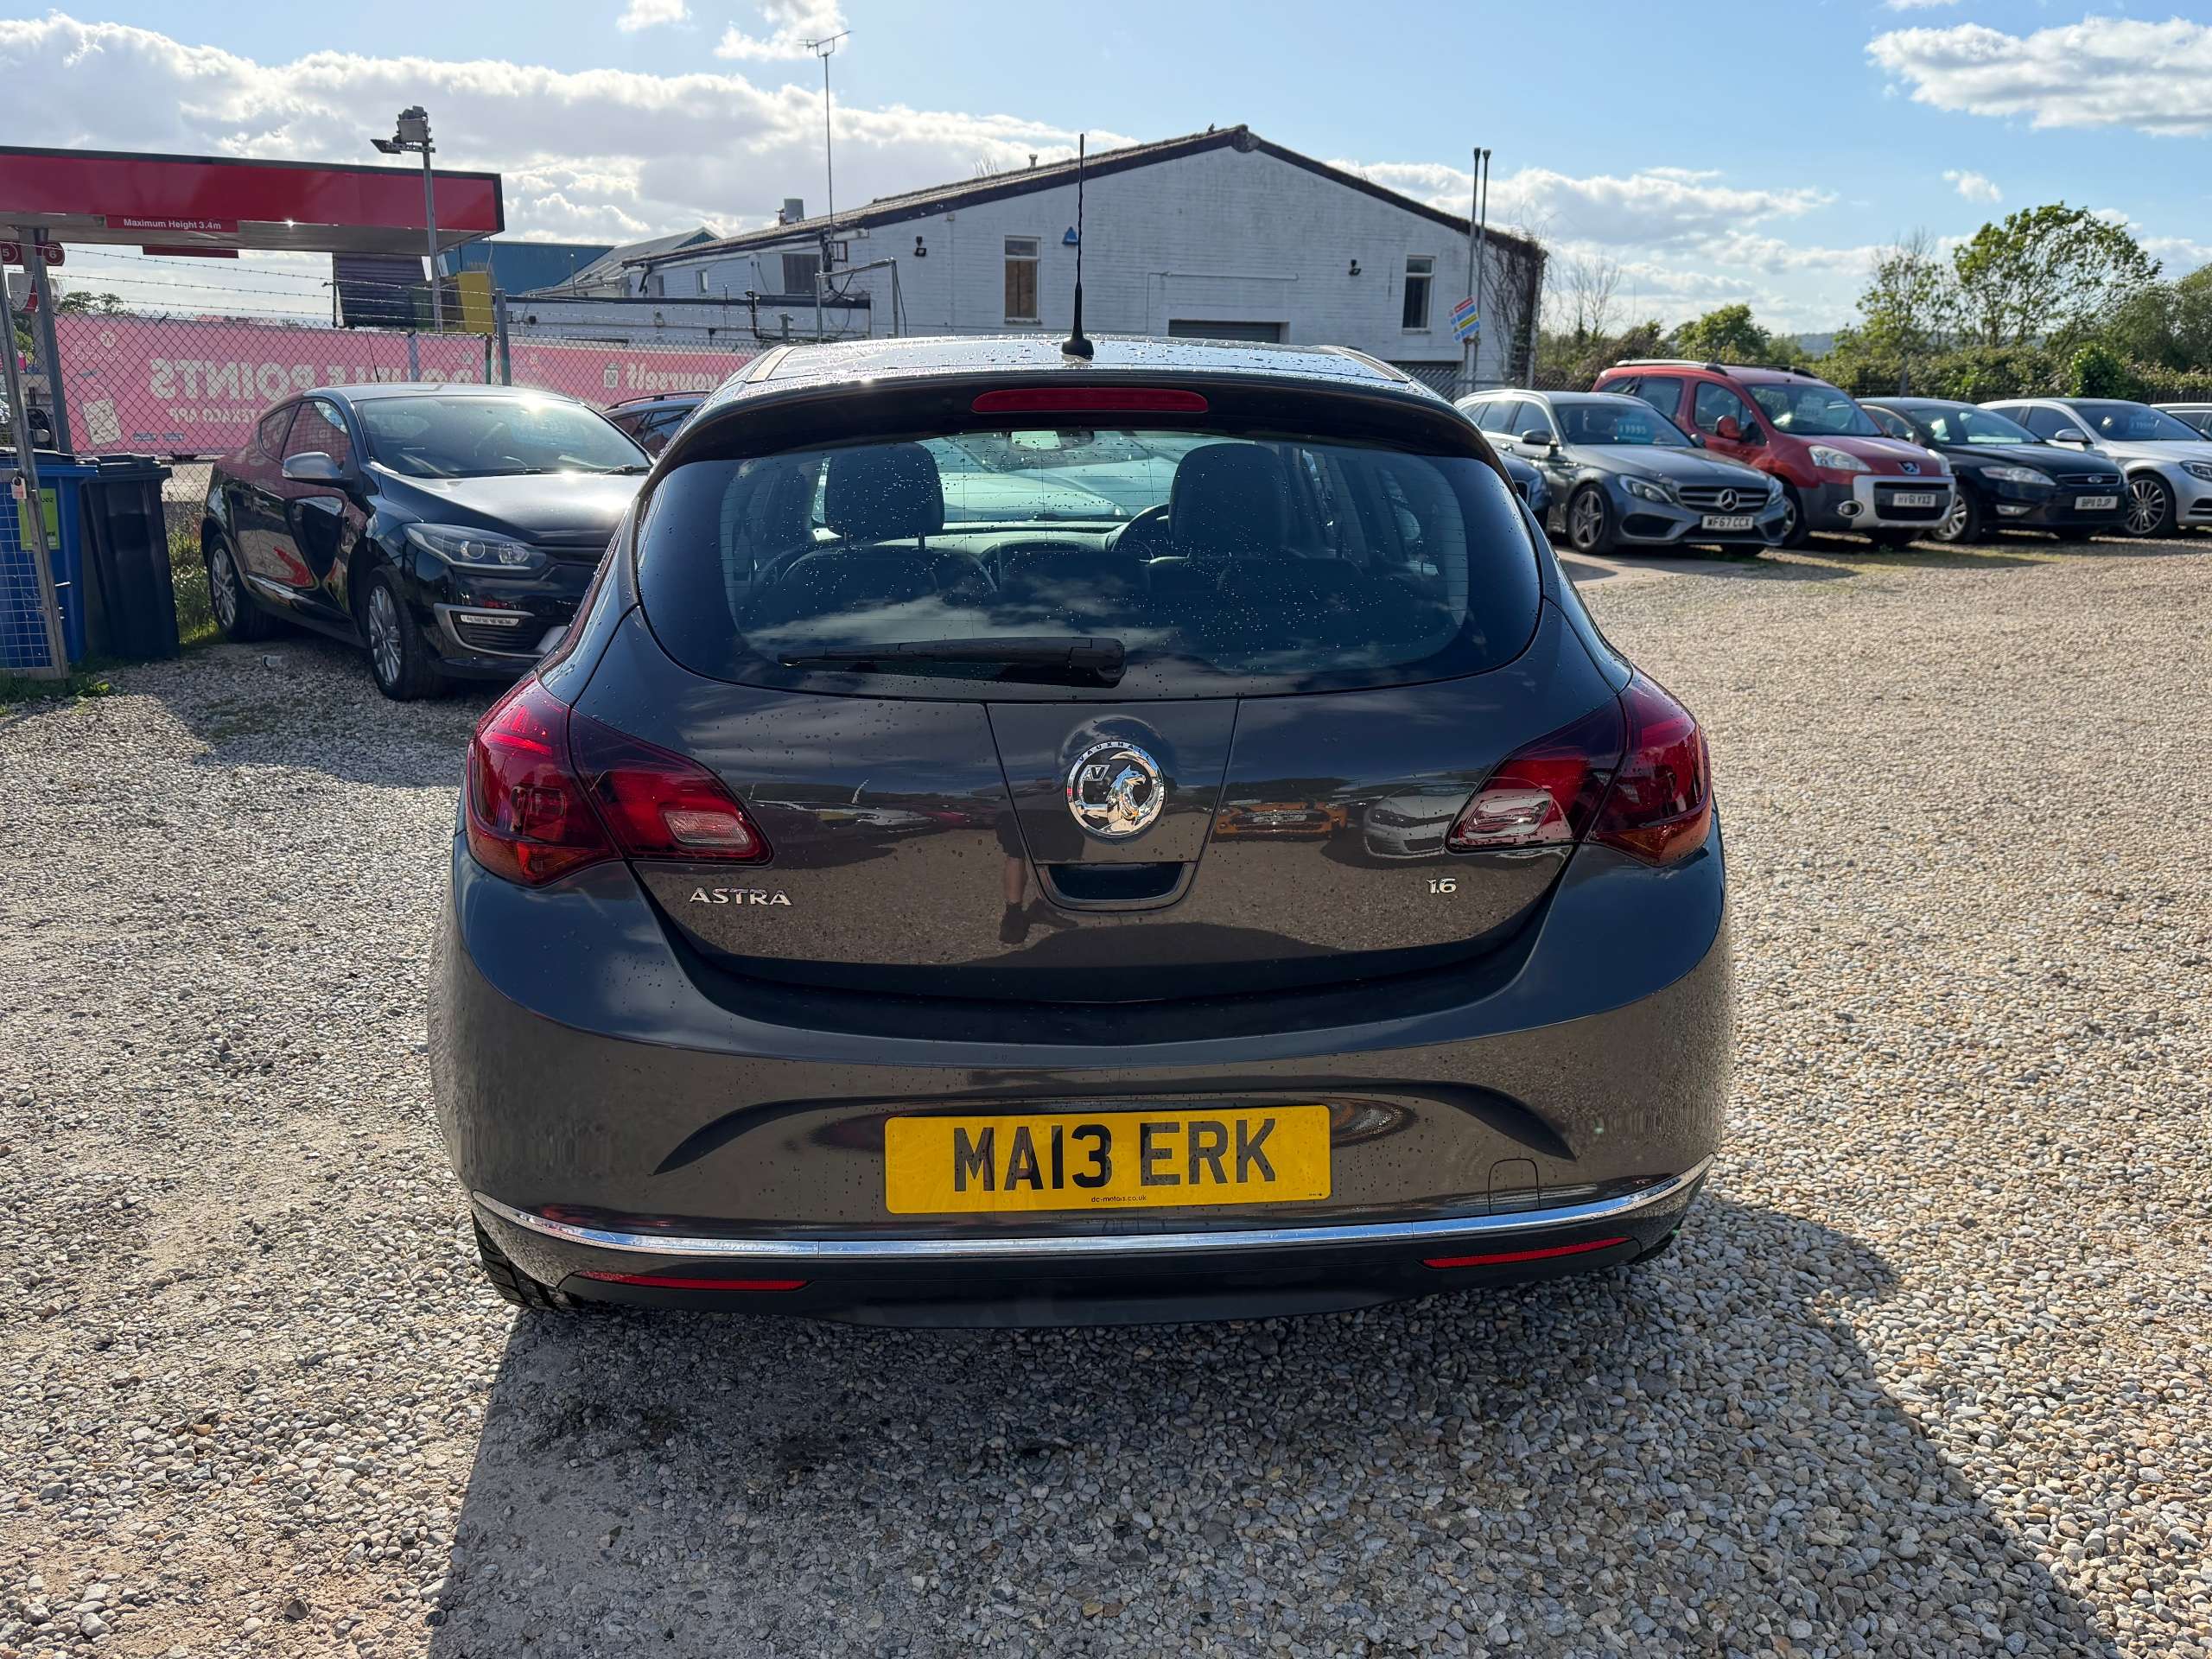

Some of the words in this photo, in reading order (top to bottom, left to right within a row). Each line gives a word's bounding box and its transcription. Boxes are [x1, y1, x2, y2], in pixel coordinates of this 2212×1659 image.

[124, 219, 167, 227] Maximum
[168, 219, 197, 230] Height
[199, 221, 222, 230] 3.4m
[2, 248, 10, 257] 5
[48, 247, 57, 259] 6
[1707, 517, 1732, 527] WF67
[1733, 517, 1750, 527] CCX
[1078, 742, 1150, 761] VAUXHALL
[1426, 878, 1457, 893] 1.6
[689, 887, 793, 906] ASTRA
[953, 1124, 1112, 1192] MA13
[1139, 1118, 1276, 1186] ERK
